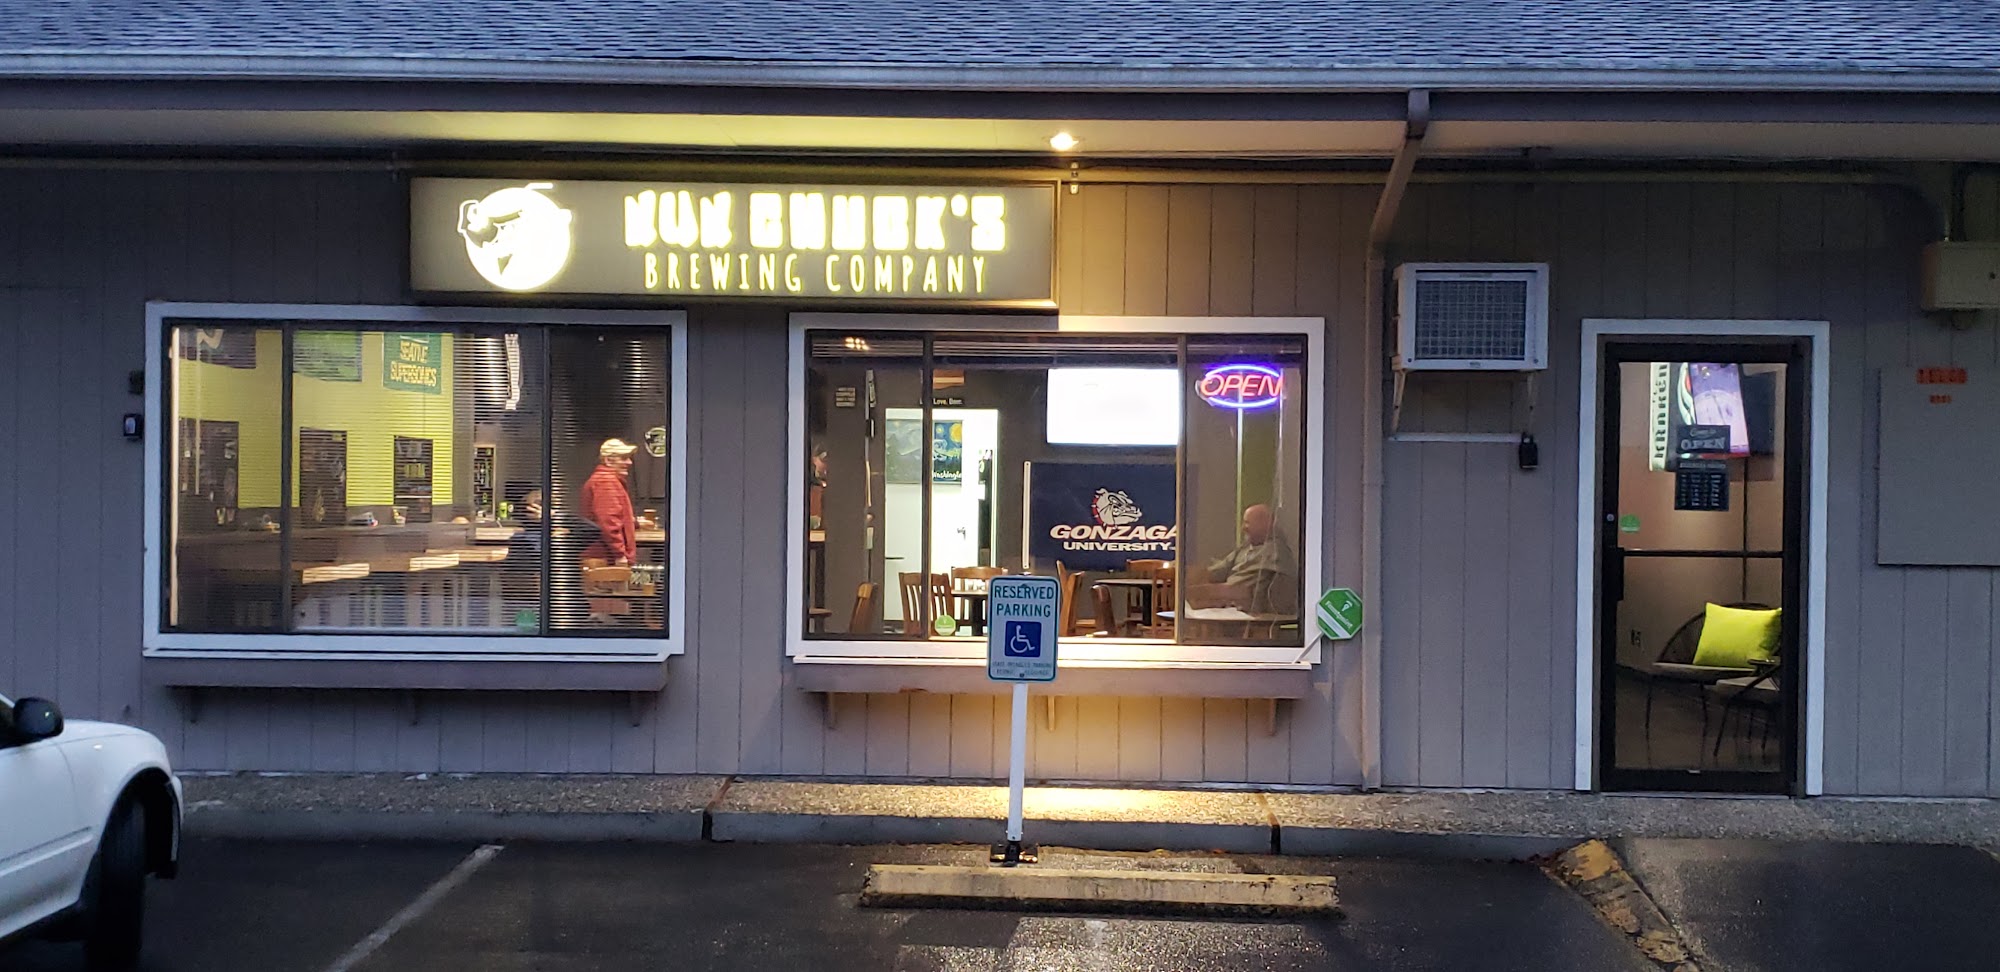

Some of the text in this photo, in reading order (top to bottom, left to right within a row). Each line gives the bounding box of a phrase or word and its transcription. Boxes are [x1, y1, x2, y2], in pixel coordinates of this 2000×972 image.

[749, 192, 1006, 251] CHUCK'S
[644, 252, 985, 293] BREWING COMPANY
[1200, 373, 1284, 397] OPEN
[1680, 436, 1726, 450] OPEN
[1050, 524, 1177, 540] GONZAGA
[1063, 541, 1172, 551] UNIVERSITY
[994, 585, 1054, 600] RESERVED
[996, 603, 1051, 618] PARKING
